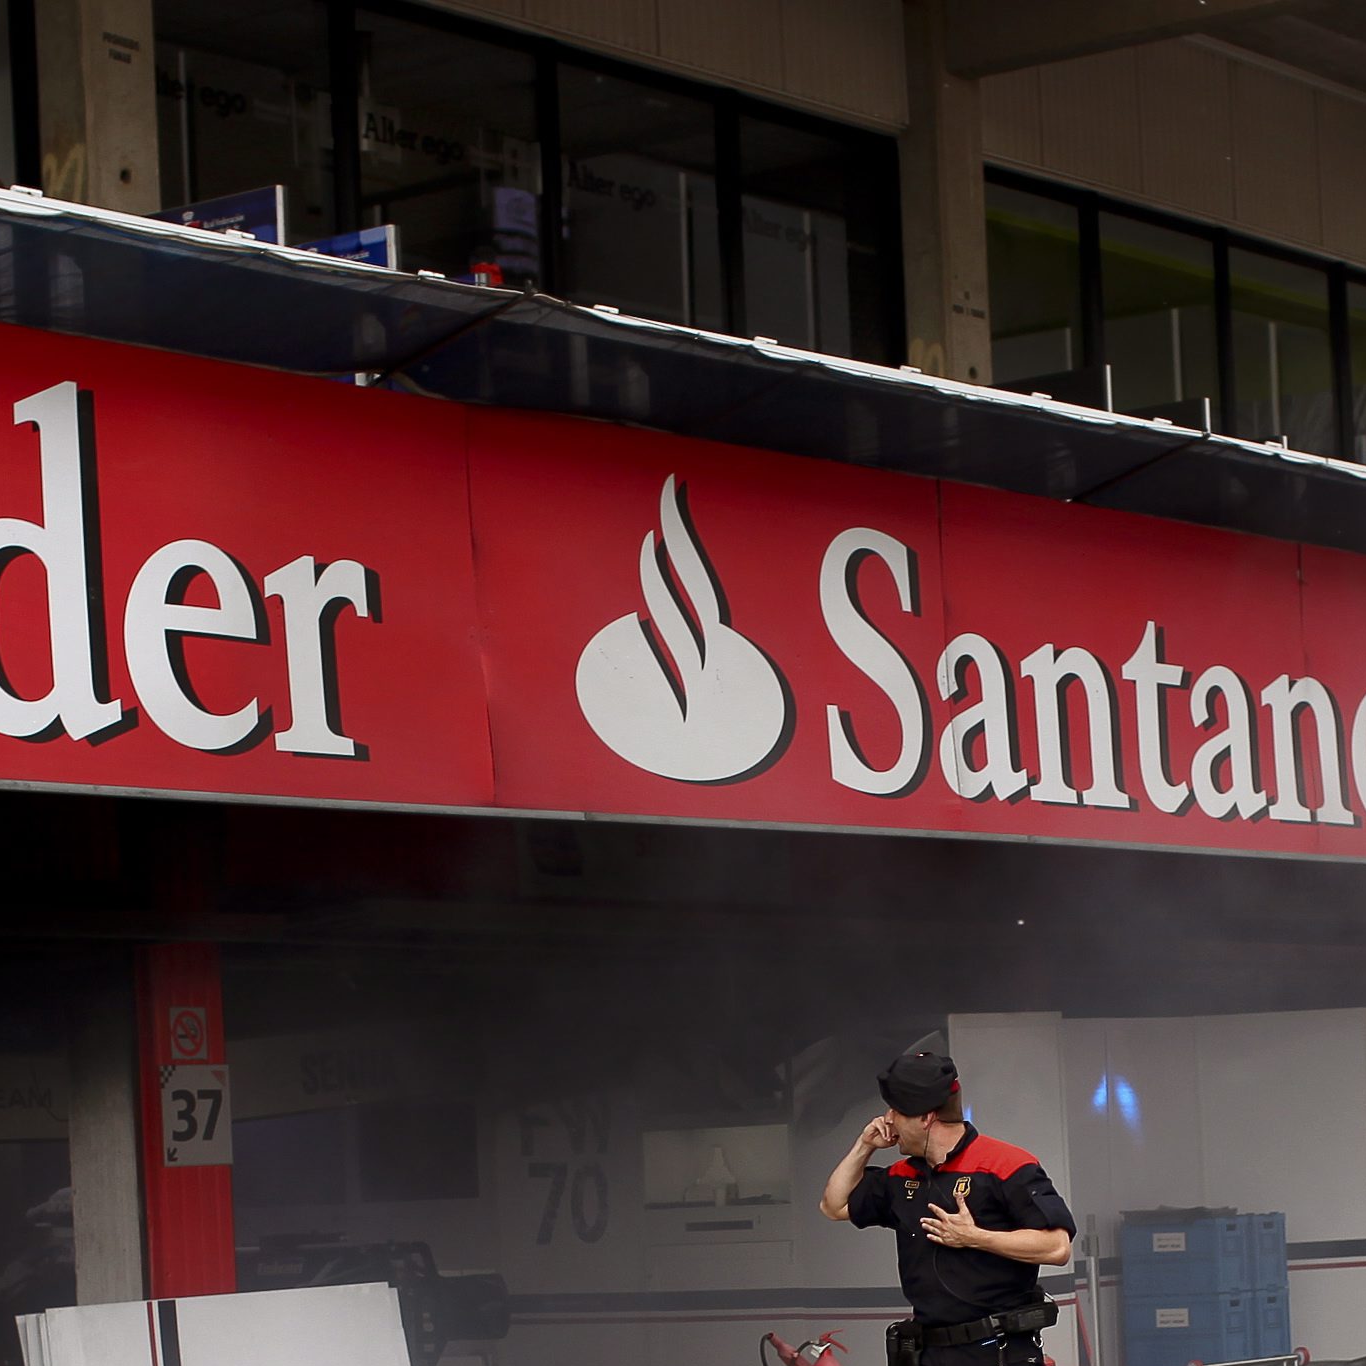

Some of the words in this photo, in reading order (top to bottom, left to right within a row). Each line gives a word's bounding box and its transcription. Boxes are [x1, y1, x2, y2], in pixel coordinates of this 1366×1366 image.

[363, 111, 417, 150] Alter
[422, 135, 464, 165] ego
[568, 159, 615, 197] Alter
[619, 183, 656, 211] ego
[171, 1088, 224, 1143] 37
[528, 1162, 609, 1245] 70
